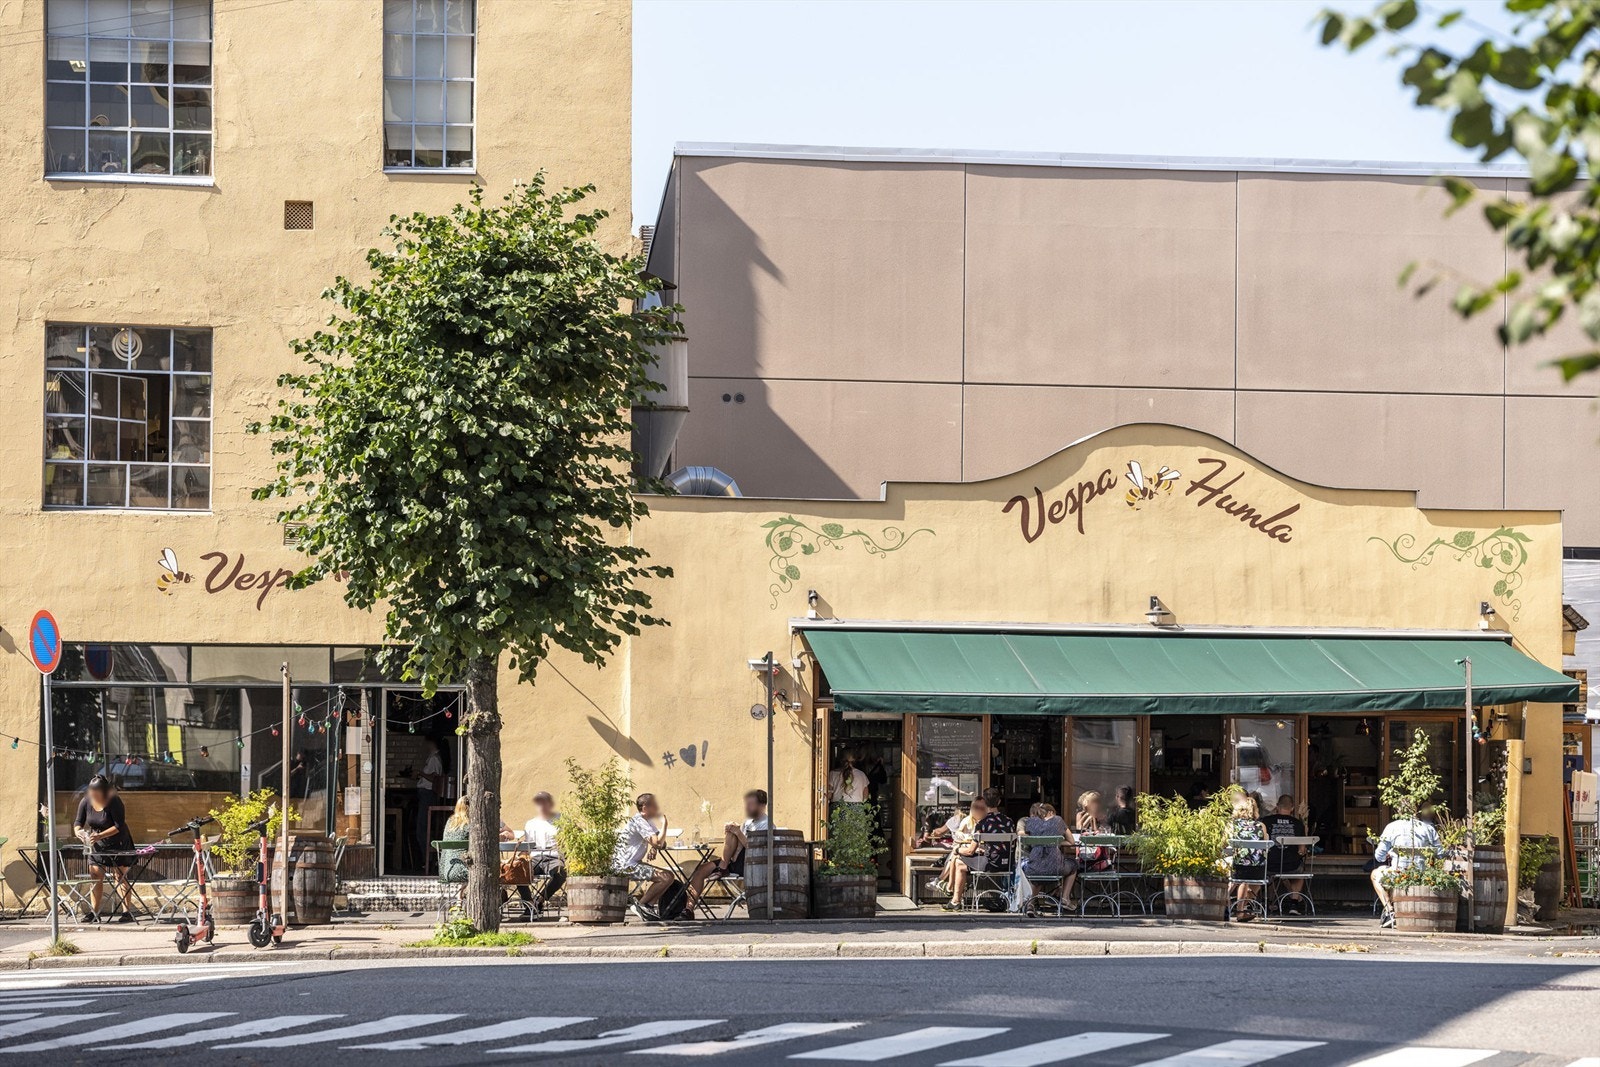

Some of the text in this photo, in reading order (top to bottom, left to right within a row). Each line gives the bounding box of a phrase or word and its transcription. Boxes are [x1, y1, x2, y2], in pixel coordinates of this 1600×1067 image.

[1001, 458, 1300, 543] Vespa Humla
[200, 551, 296, 611] Vesp
